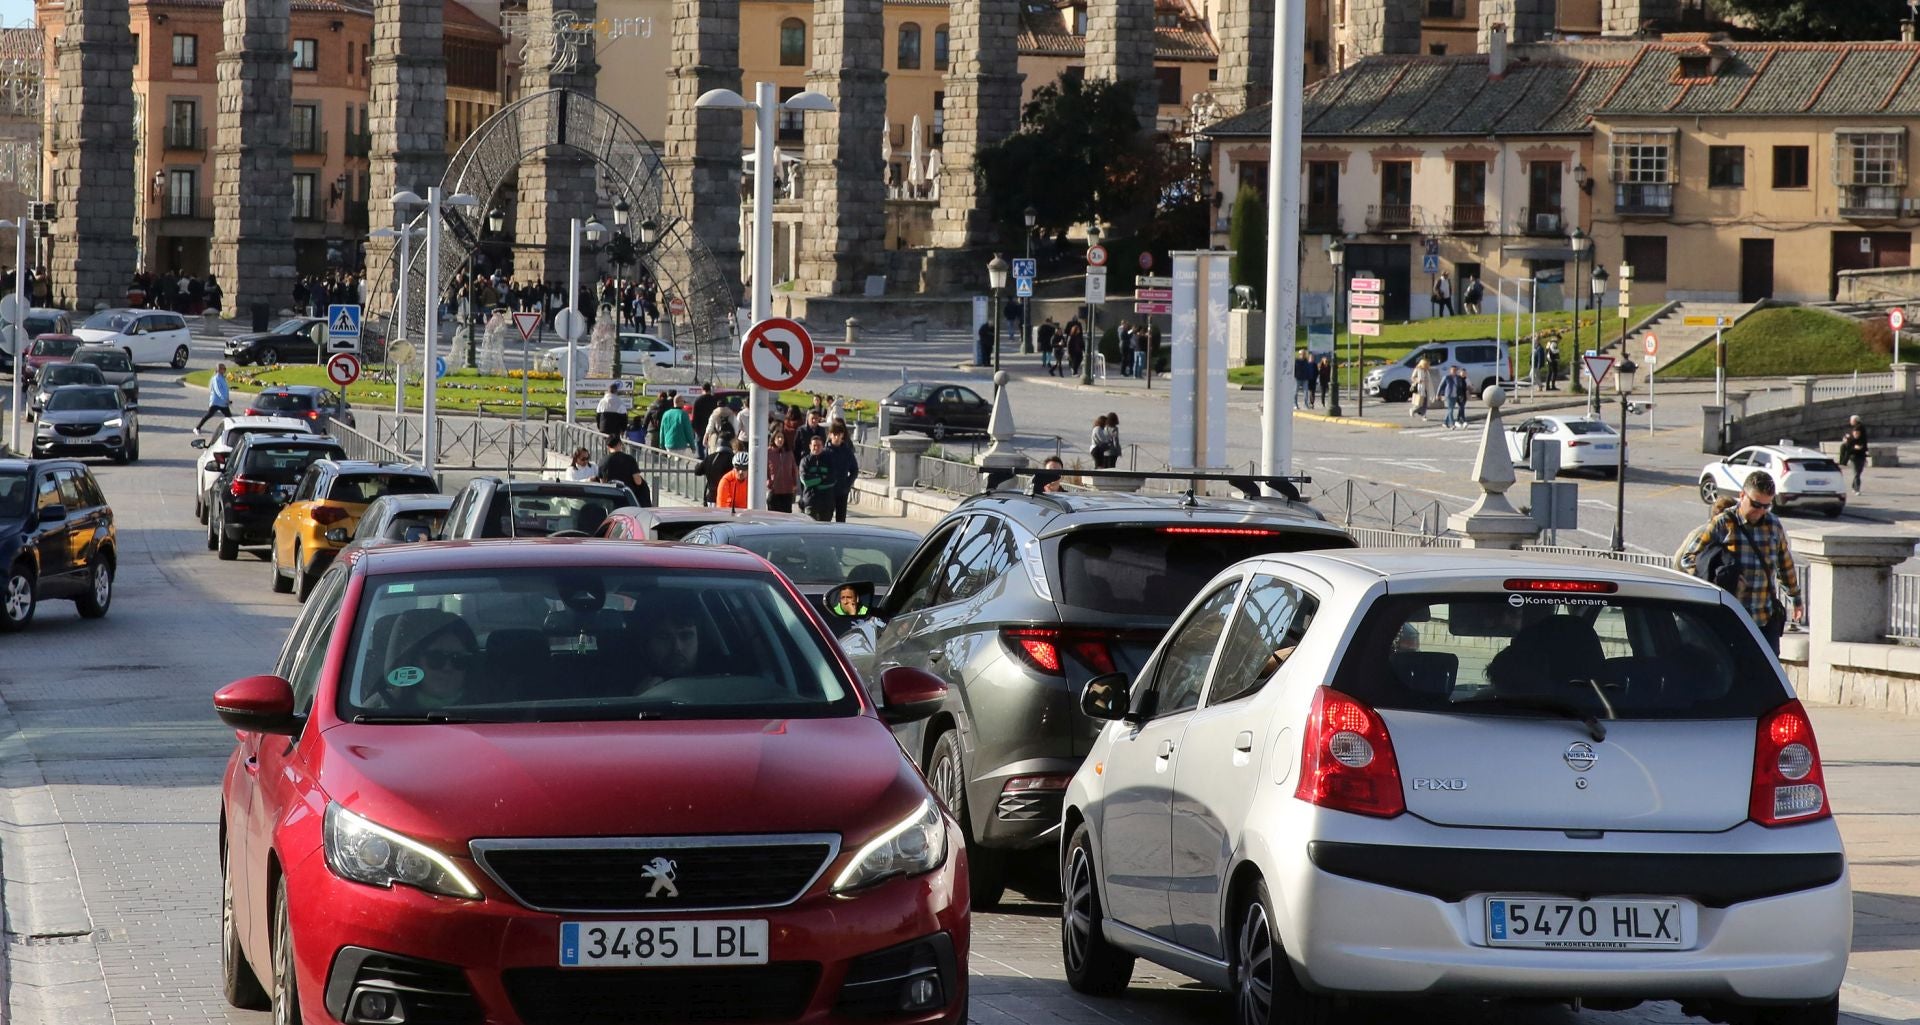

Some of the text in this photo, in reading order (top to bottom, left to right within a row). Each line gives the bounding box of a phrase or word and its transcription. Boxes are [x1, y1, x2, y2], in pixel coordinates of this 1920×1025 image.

[1525, 596, 1608, 606] Konen-Lemaire
[1413, 778, 1468, 790] PIXO
[1495, 904, 1672, 938] E 5470 HLX
[567, 926, 759, 959] E 3485 LBL
